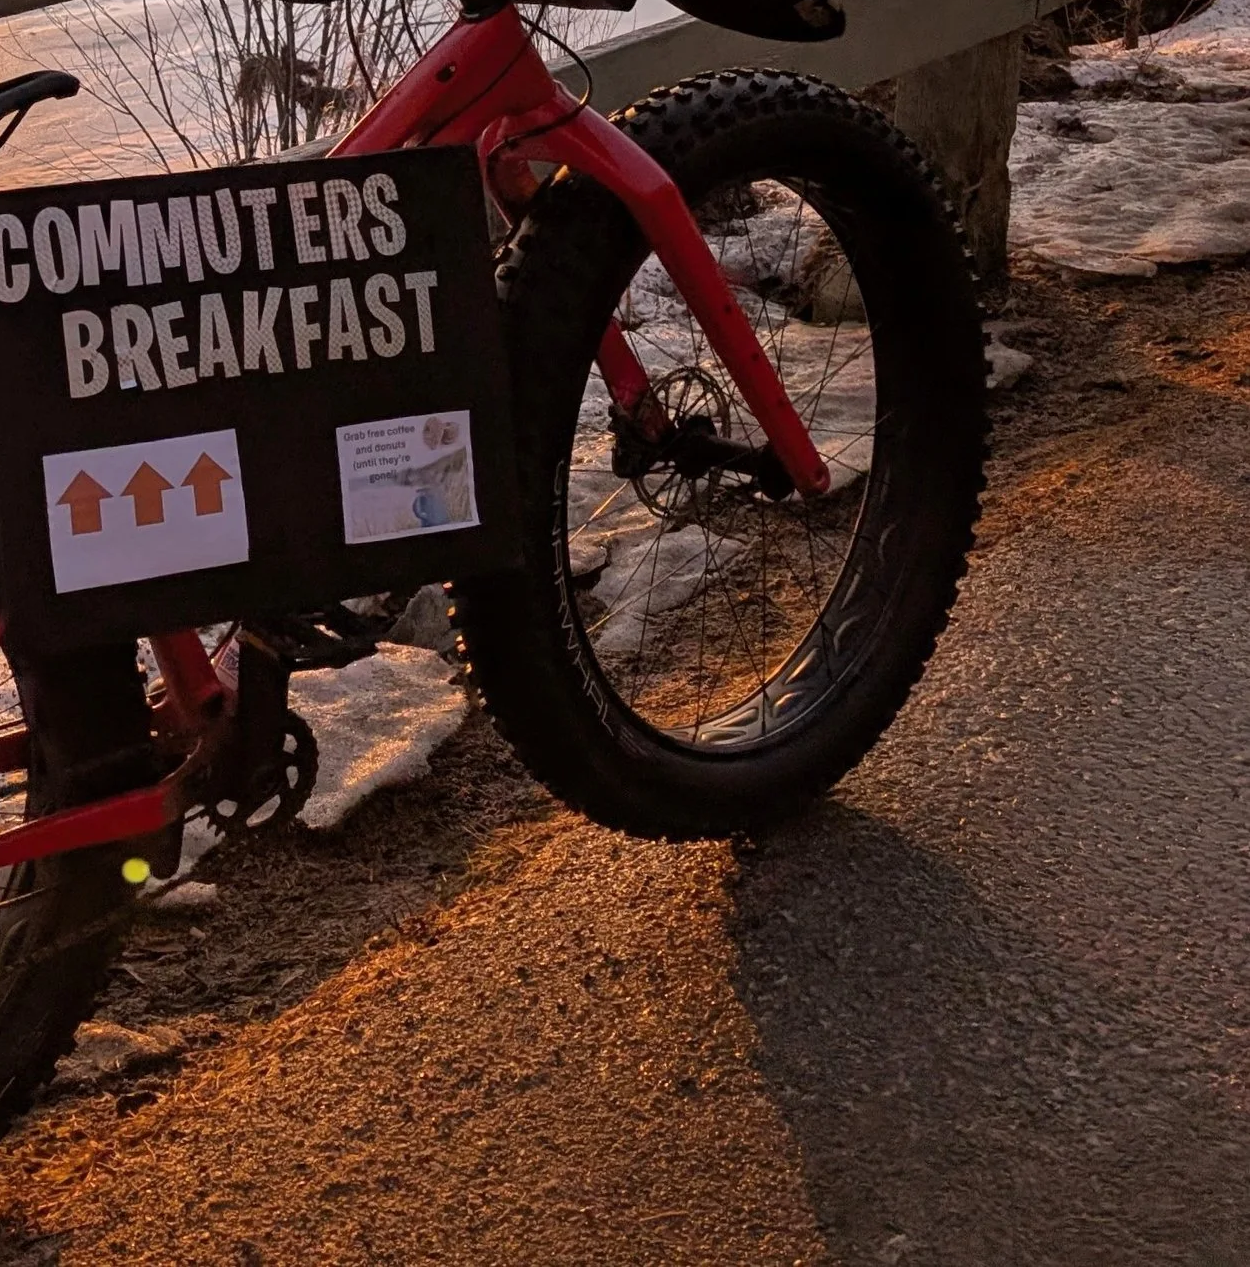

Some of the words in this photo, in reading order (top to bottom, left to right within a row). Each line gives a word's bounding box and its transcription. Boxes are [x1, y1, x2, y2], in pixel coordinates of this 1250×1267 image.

[63, 270, 438, 398] BREAKFAST
[343, 431, 366, 441] Grab
[367, 429, 385, 438] free
[387, 425, 415, 436] coffee
[355, 444, 373, 455] and
[375, 441, 406, 452] donuts
